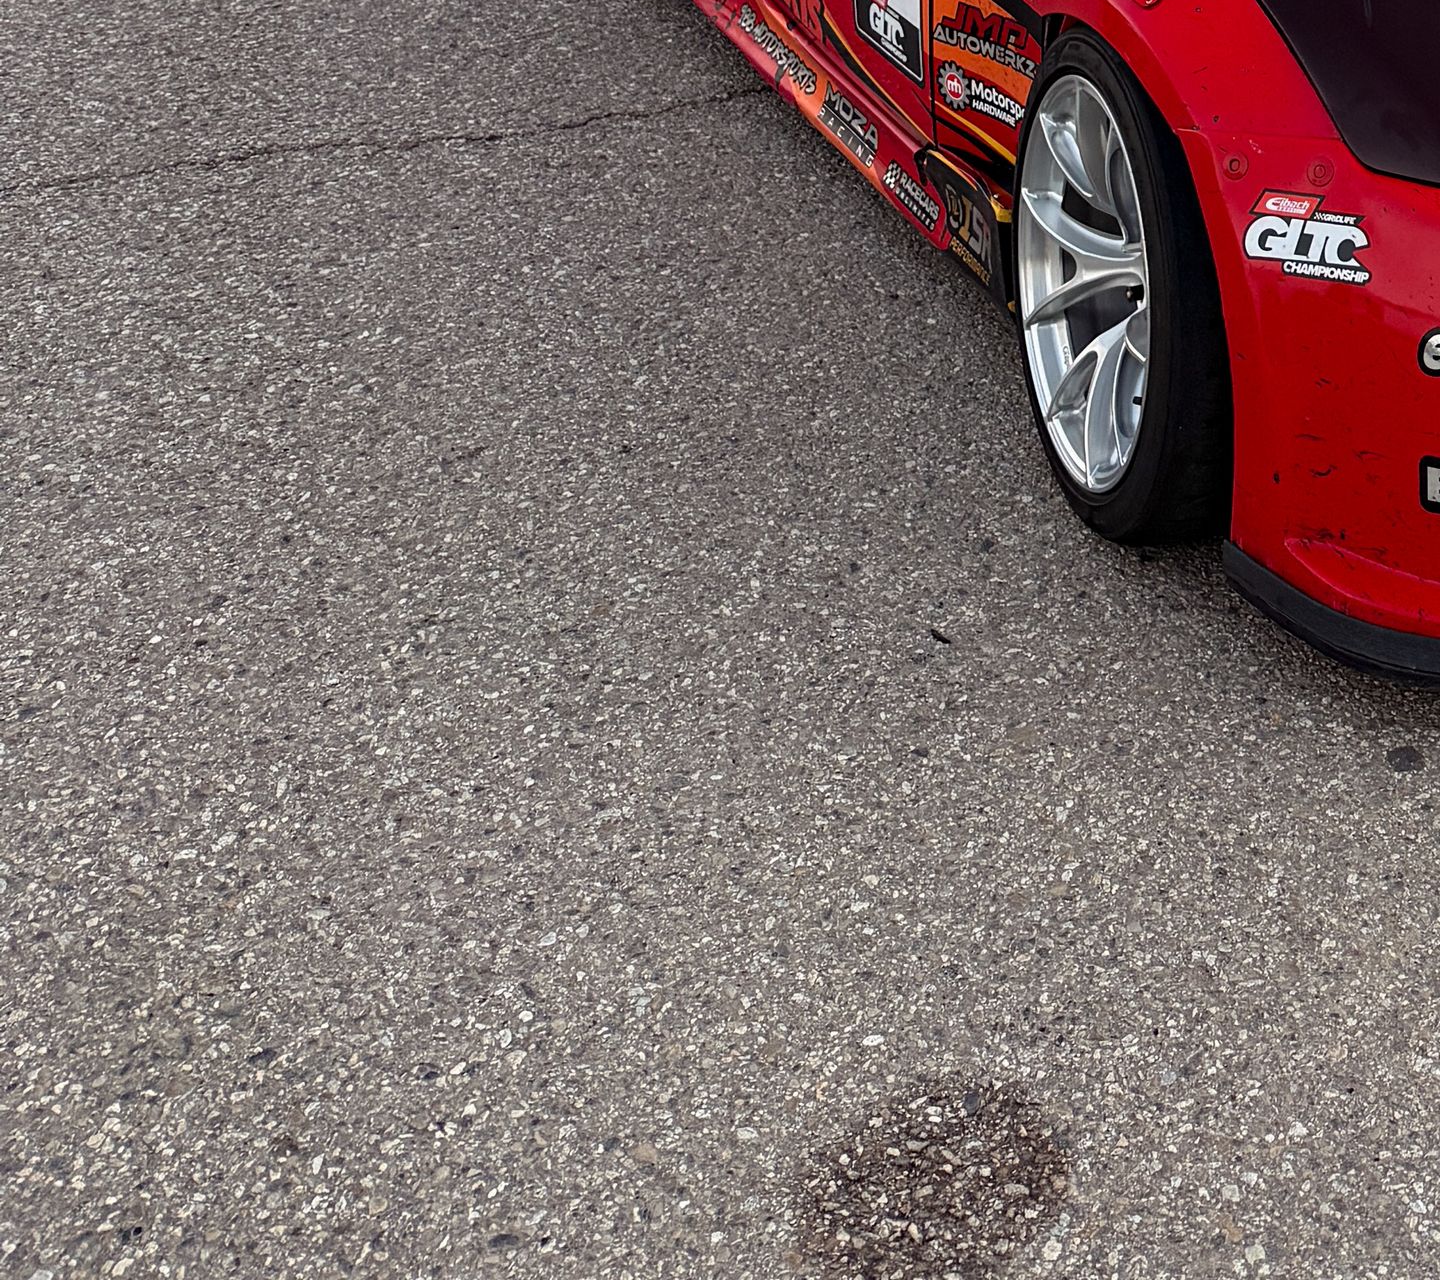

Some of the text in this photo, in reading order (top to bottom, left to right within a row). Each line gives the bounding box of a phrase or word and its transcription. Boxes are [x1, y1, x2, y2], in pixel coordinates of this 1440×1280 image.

[869, 2, 905, 52] GLTC
[933, 24, 1037, 79] AUTOWERKZ
[754, 22, 817, 93] MOTORSPORTS
[817, 106, 875, 169] RACING
[824, 83, 878, 151] MOZA
[972, 98, 1017, 127] HARDWARE
[900, 172, 940, 221] RACECARS
[1265, 196, 1311, 215] Eibach
[949, 235, 991, 287] PERFORMANCE
[1245, 215, 1369, 267] GLTC
[1283, 260, 1370, 283] CHAMPIONSHIP
